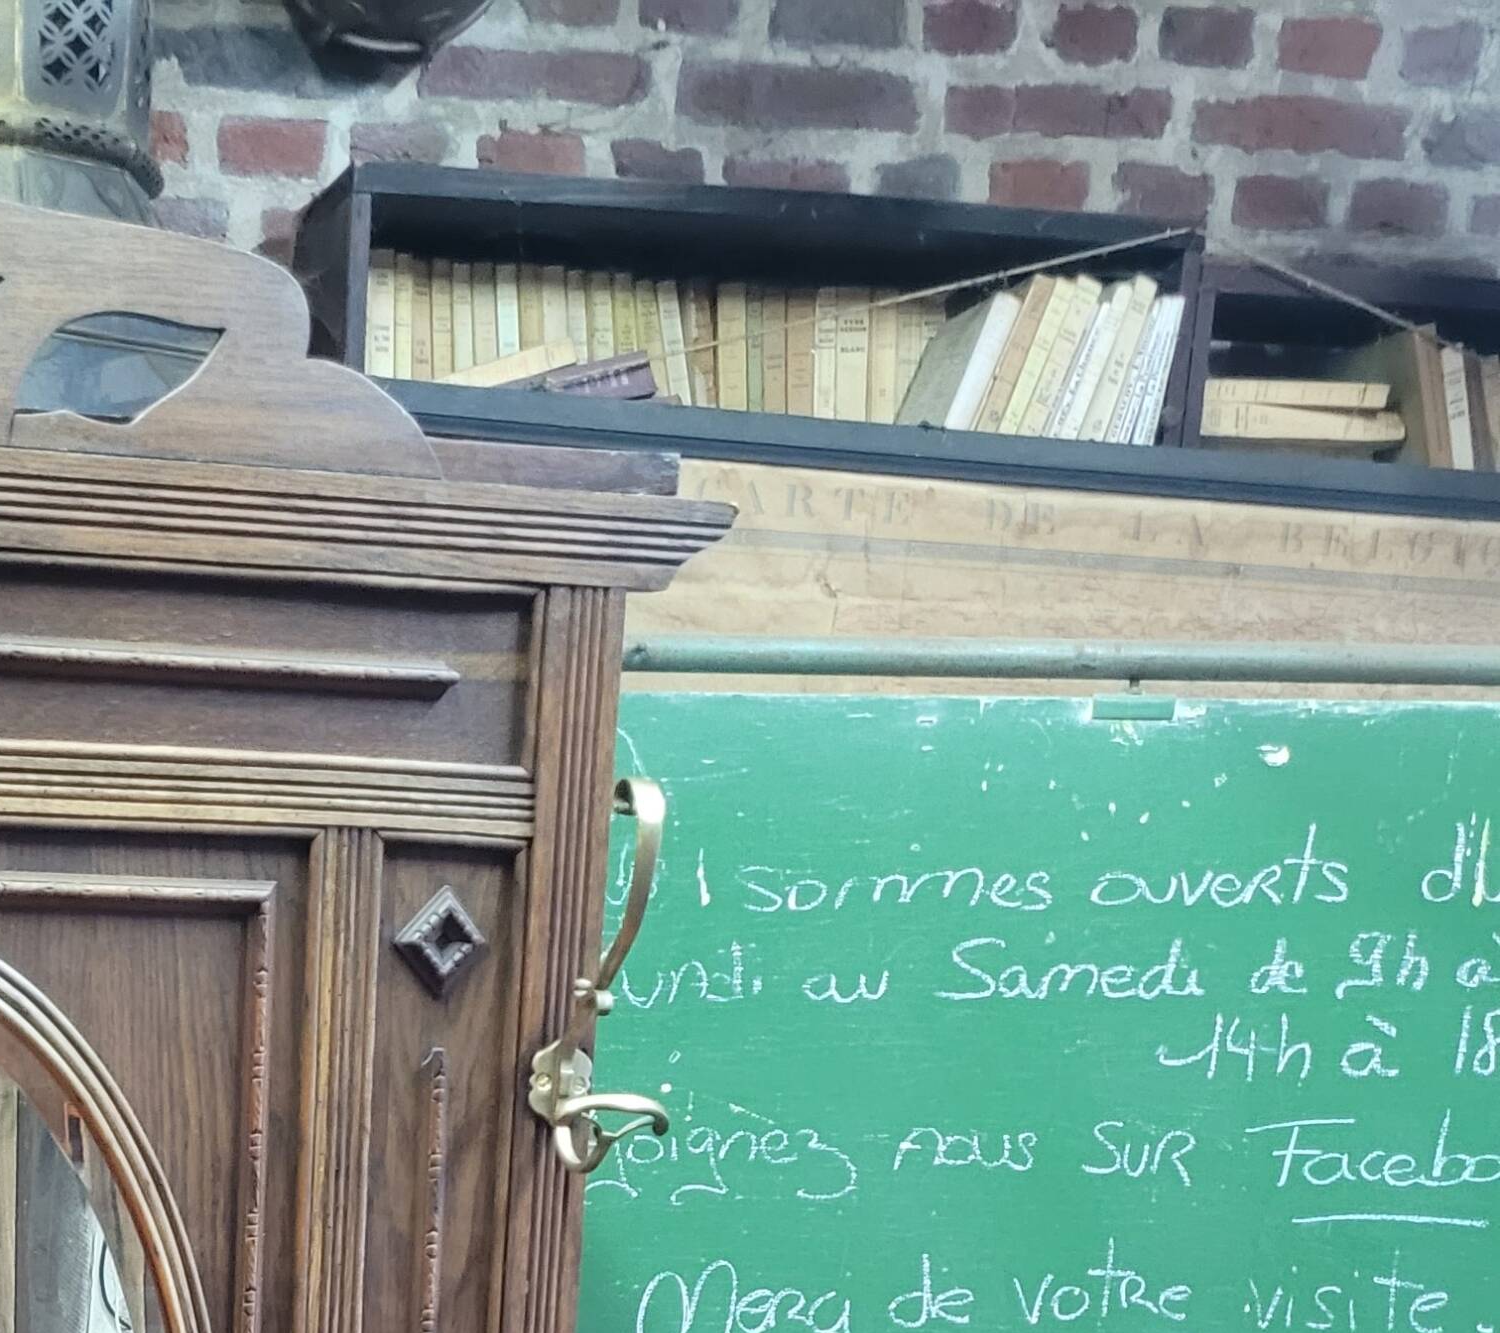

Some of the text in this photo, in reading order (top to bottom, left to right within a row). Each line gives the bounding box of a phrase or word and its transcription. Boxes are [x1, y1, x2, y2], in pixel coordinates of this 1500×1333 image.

[610, 938, 764, 1009] undi
[932, 935, 1205, 1001] Samedi
[1339, 1013, 1400, 1078] à
[887, 1252, 975, 1329] de
